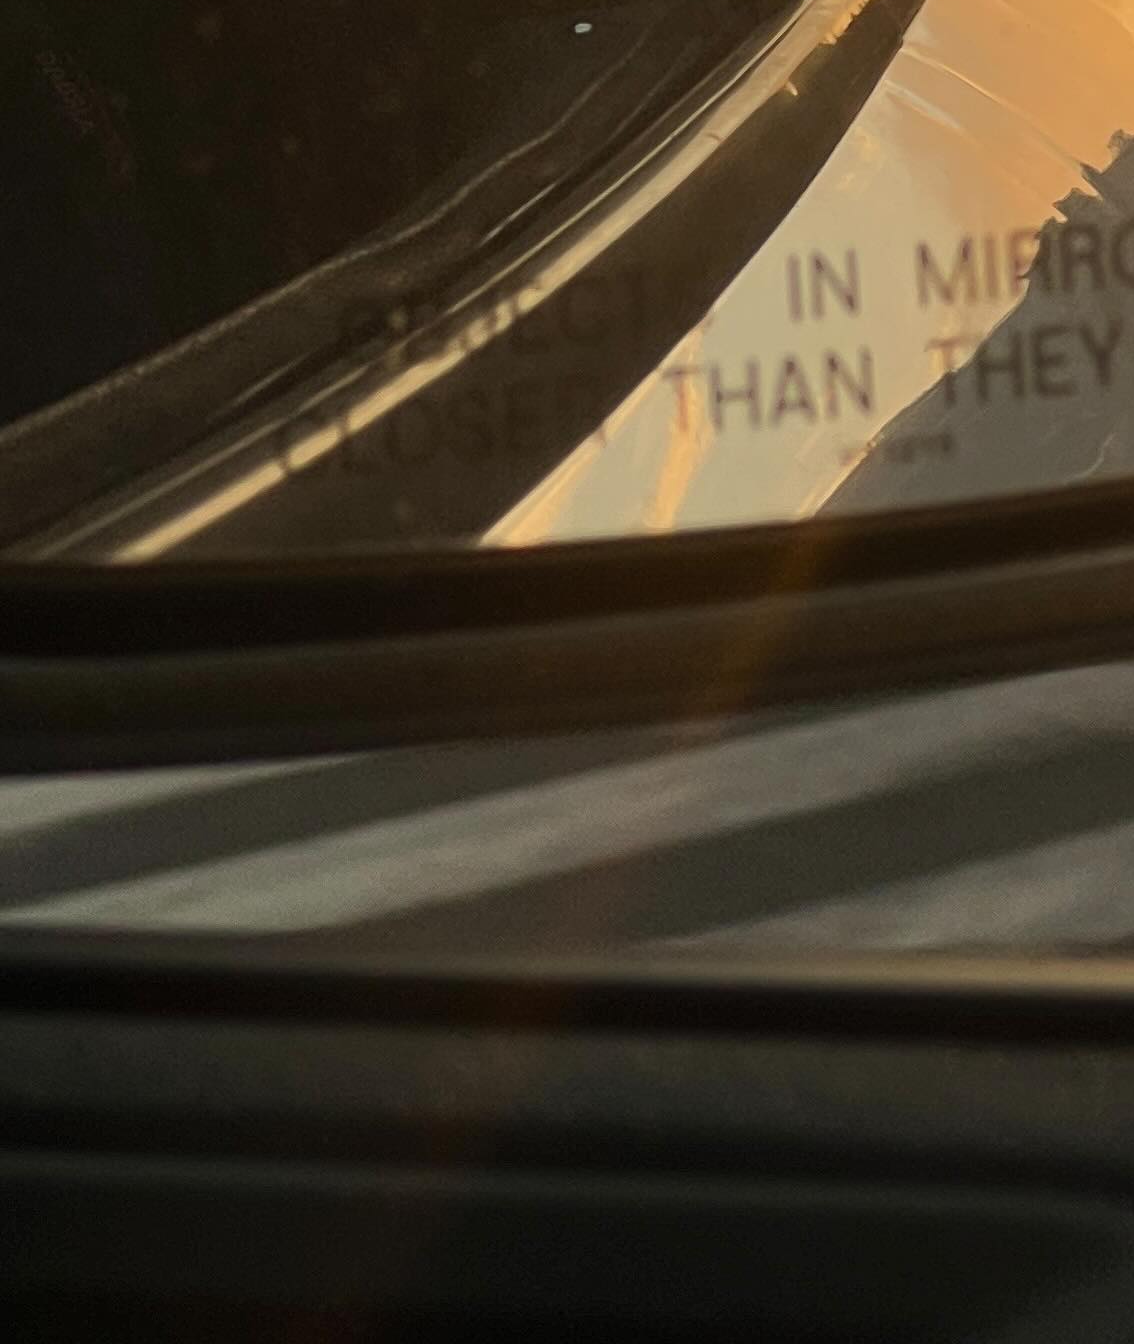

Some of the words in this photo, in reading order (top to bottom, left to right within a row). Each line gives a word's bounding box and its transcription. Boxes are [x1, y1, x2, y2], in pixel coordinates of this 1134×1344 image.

[336, 260, 712, 364] OBJECT
[786, 248, 861, 322] IN
[660, 346, 874, 434] THAN
[926, 319, 1122, 410] THEY
